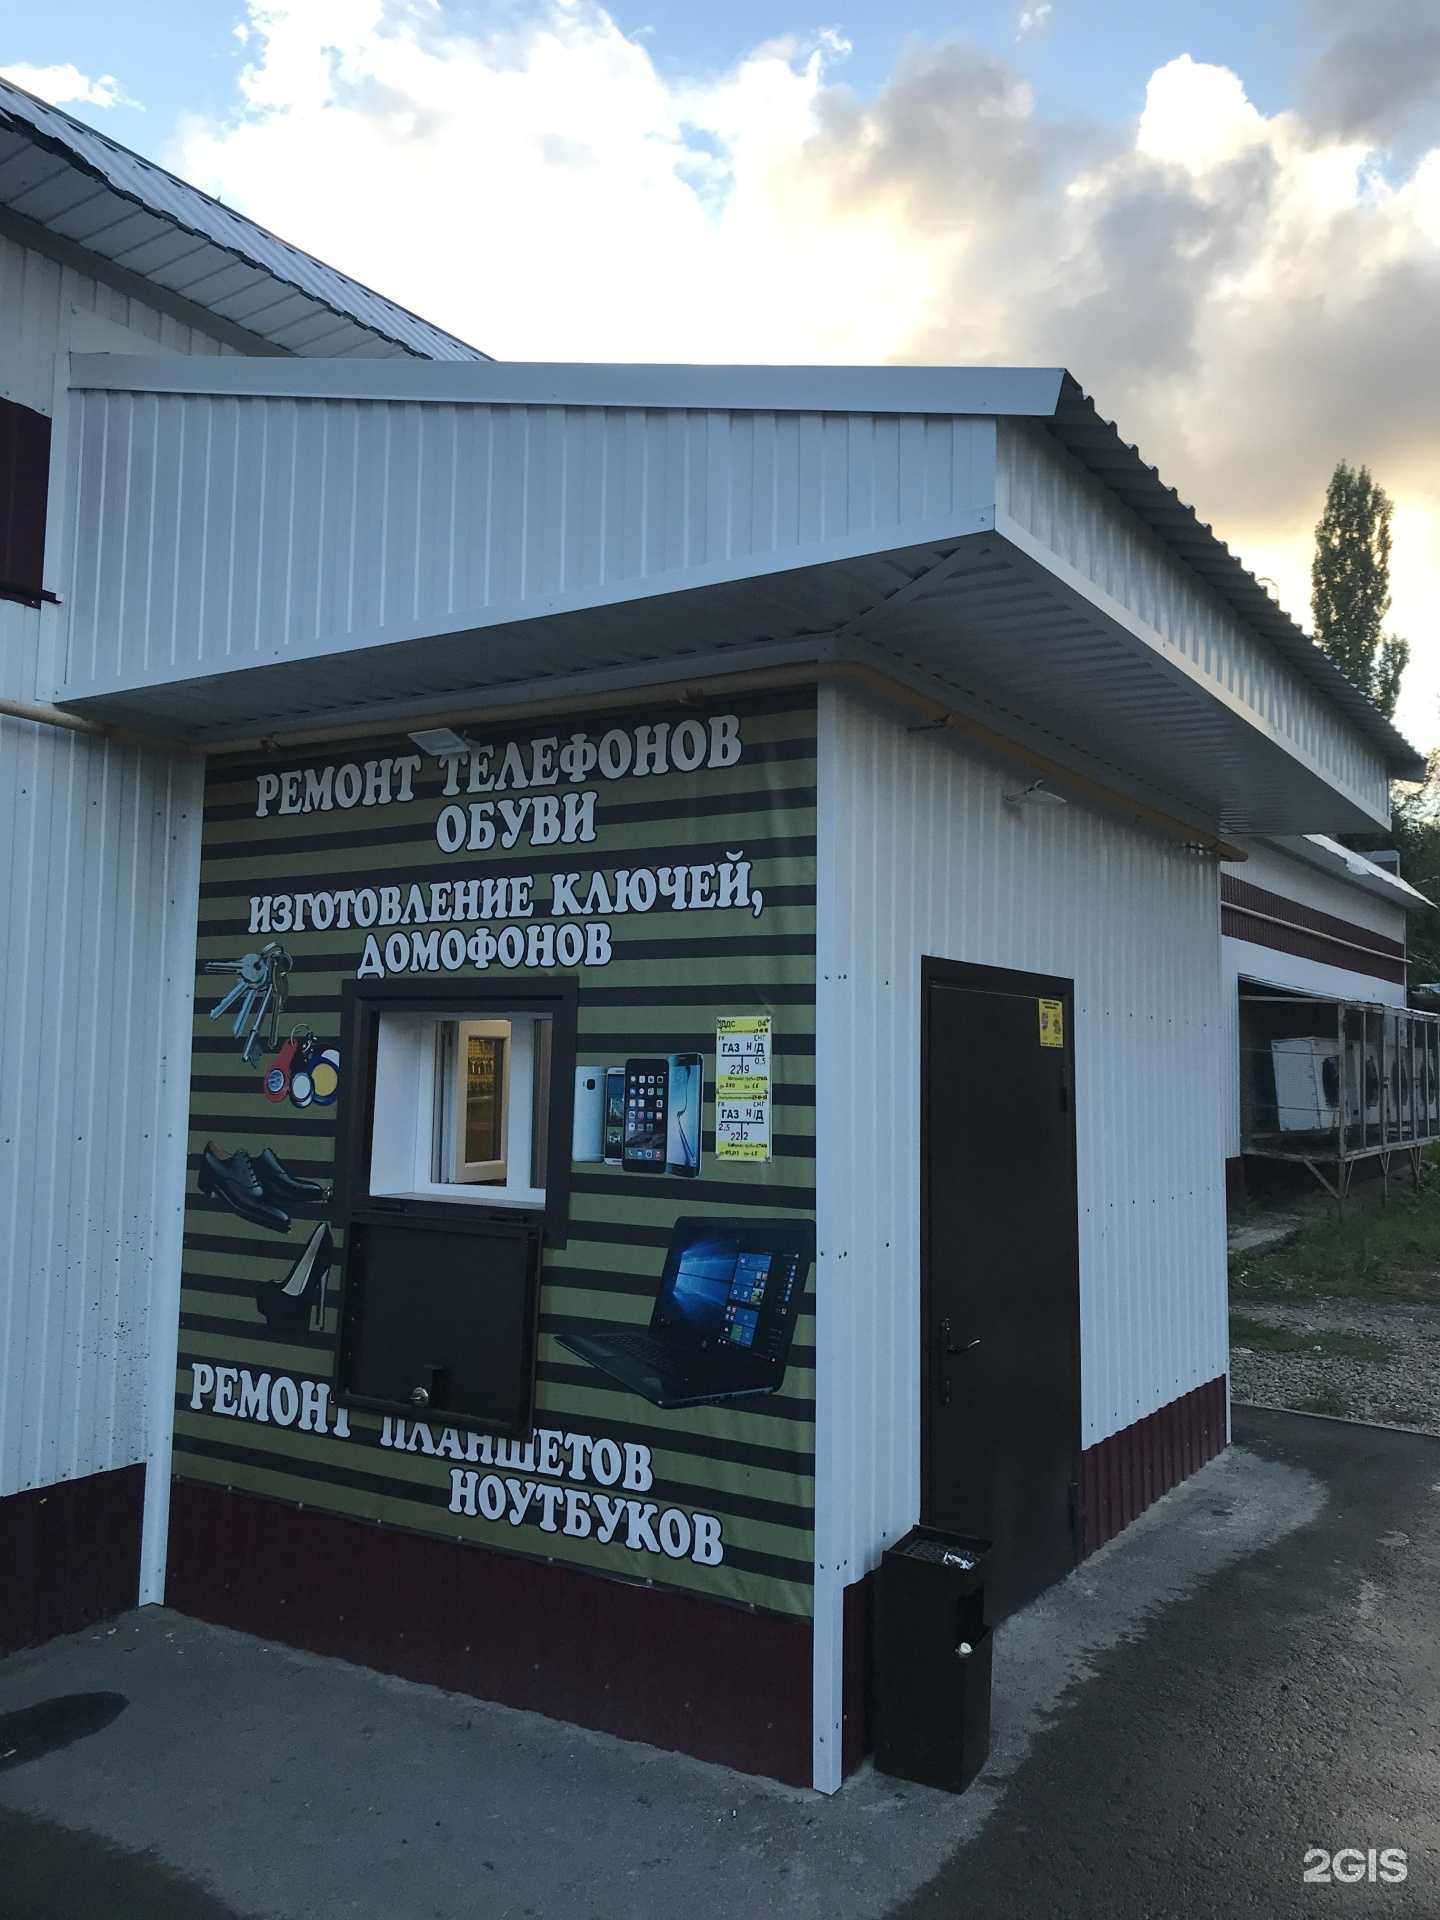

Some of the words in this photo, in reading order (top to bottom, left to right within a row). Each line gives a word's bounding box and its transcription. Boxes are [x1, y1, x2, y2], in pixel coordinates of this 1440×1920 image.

[255, 755, 421, 817] РЕМОНТ
[438, 714, 743, 796] ТЕЛЕФОНОВ
[436, 791, 598, 853] ОБУВИ
[248, 875, 533, 934] ИЗГОТОВЛЕНИЕ
[551, 851, 763, 917] КЛЮЧЕЙ,
[356, 922, 612, 978] ДОМОФОНОВ
[722, 1042, 740, 1053] ГАЗ
[721, 1109, 739, 1119] ГАЗ
[448, 1468, 724, 1566] НОУТБУКОВ
